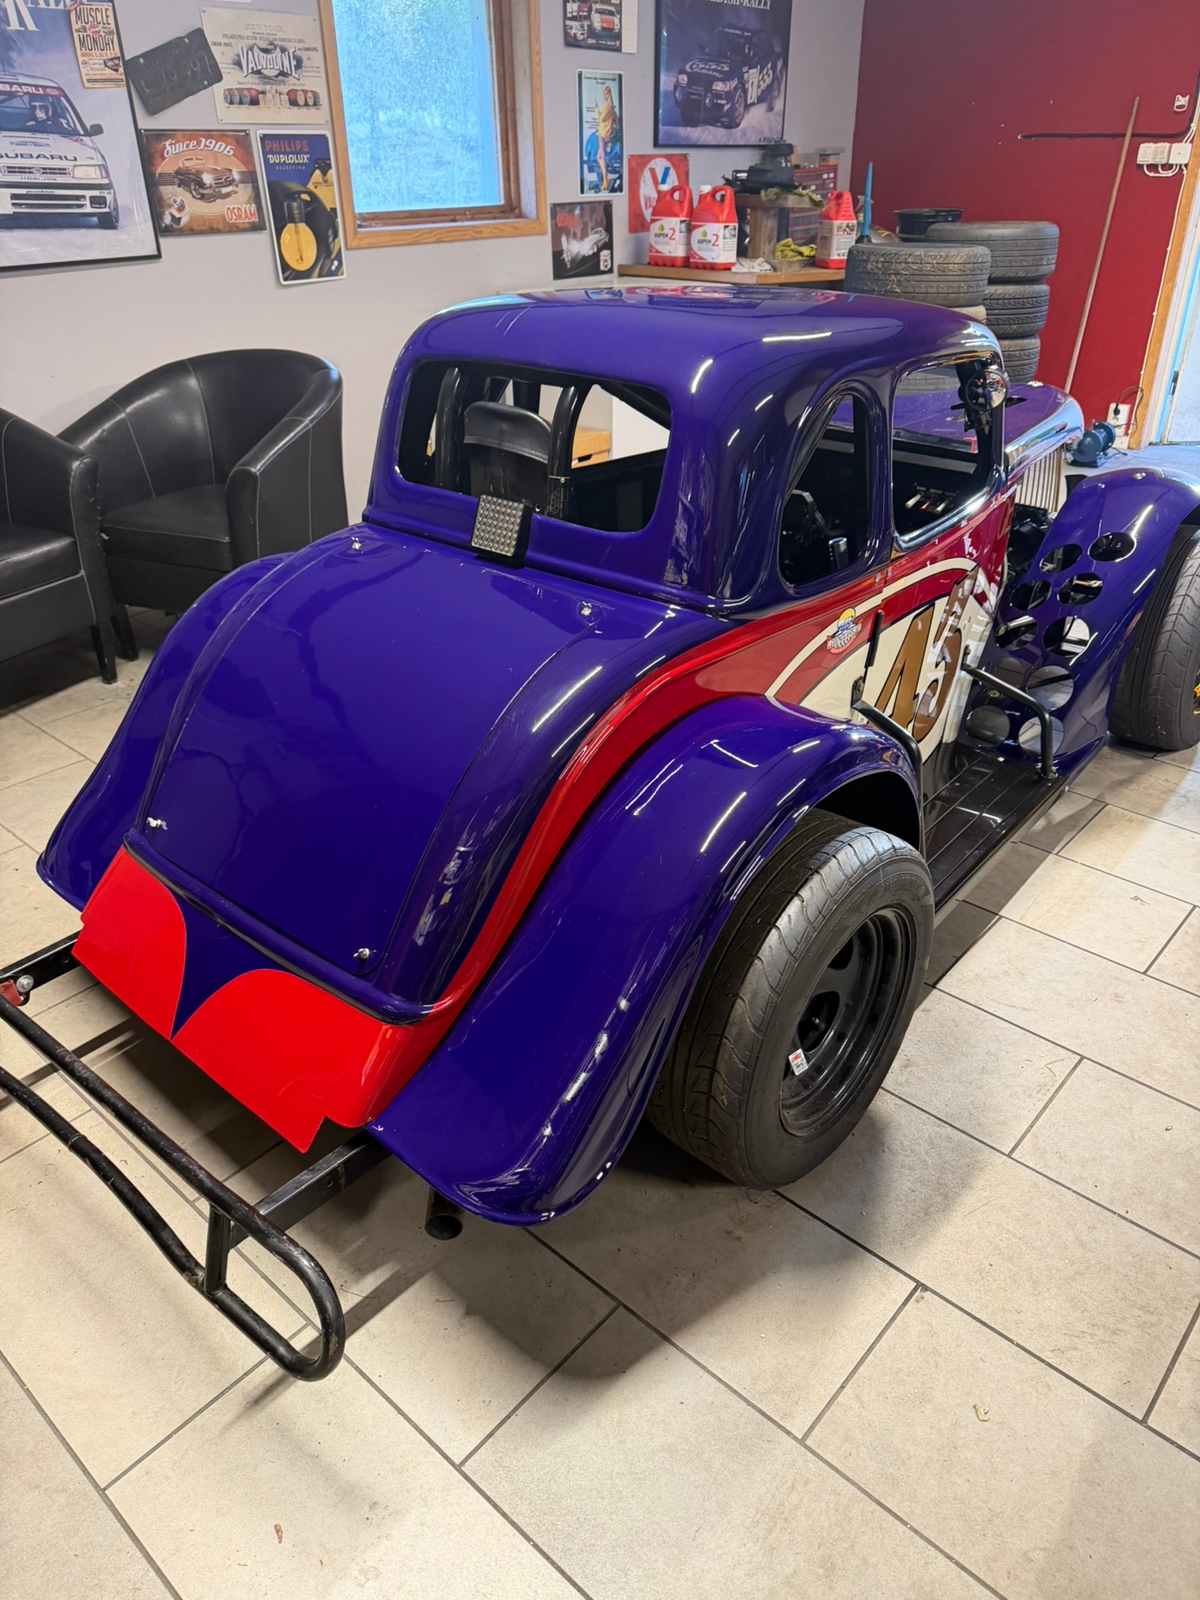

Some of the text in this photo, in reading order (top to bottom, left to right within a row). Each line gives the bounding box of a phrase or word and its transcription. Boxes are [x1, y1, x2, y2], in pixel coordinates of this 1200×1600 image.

[75, 7, 111, 25] MUSCLE
[78, 34, 115, 52] MONDAY
[237, 43, 300, 81] VALVOLINE
[161, 138, 236, 158] Since 1906
[264, 140, 309, 152] PHILIPS
[224, 204, 259, 222] OSRAM
[668, 227, 676, 241] 2
[711, 233, 719, 247] 2
